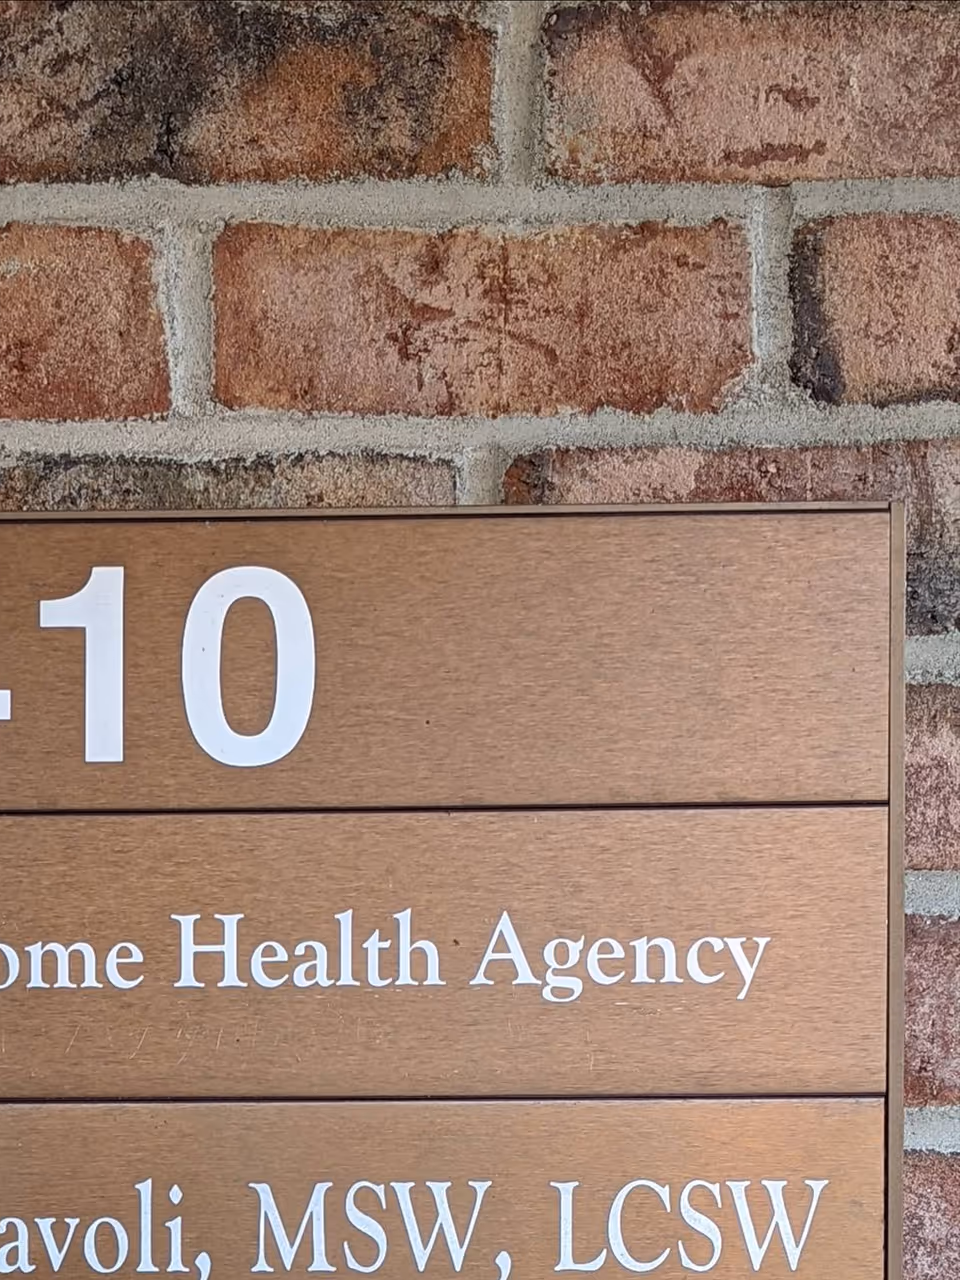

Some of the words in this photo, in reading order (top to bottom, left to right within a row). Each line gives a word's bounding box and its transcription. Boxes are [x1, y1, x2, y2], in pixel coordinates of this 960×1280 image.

[170, 907, 445, 988] Health
[470, 909, 771, 1000] Agency
[550, 1178, 829, 1273] LCSW
